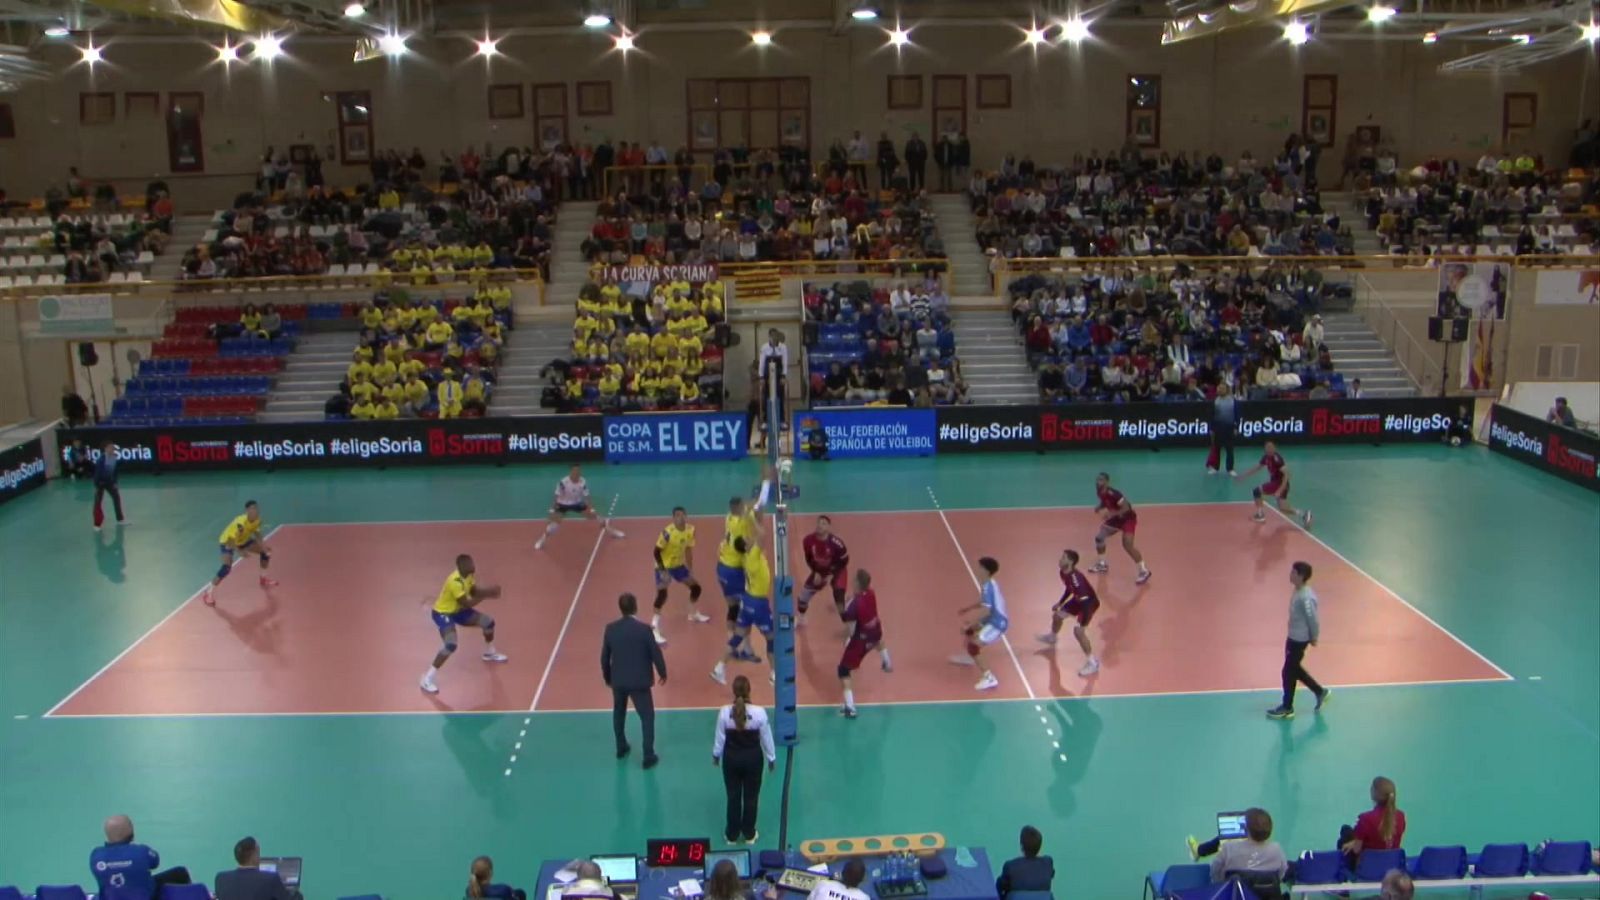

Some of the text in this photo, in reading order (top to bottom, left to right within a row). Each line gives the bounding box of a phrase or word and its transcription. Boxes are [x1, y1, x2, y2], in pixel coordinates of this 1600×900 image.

[621, 266, 660, 281] CURVA
[607, 423, 652, 437] COPA
[825, 422, 908, 437] REAL FEDERACIÓN
[939, 423, 1032, 443] #eligeSoria
[1059, 419, 1114, 441] Soria
[1118, 417, 1209, 438] #eligeSoria
[1238, 416, 1304, 437] igeSoria
[1329, 415, 1380, 436] Soria
[1384, 413, 1451, 433] #eligeSo
[447, 434, 503, 456] Soria
[508, 433, 602, 453] #eligeSoria
[658, 420, 741, 452] EL REY
[874, 438, 888, 449] DE
[889, 436, 932, 448] VOLEIBOL
[1491, 421, 1543, 456] #eligeSoria
[175, 441, 229, 461] Soria
[234, 440, 325, 460] #eligeSoria
[330, 437, 422, 458] #eligeSoria
[608, 440, 653, 453] DE S.M.
[0, 456, 44, 488] eligeSoria
[688, 843, 703, 860] 13
